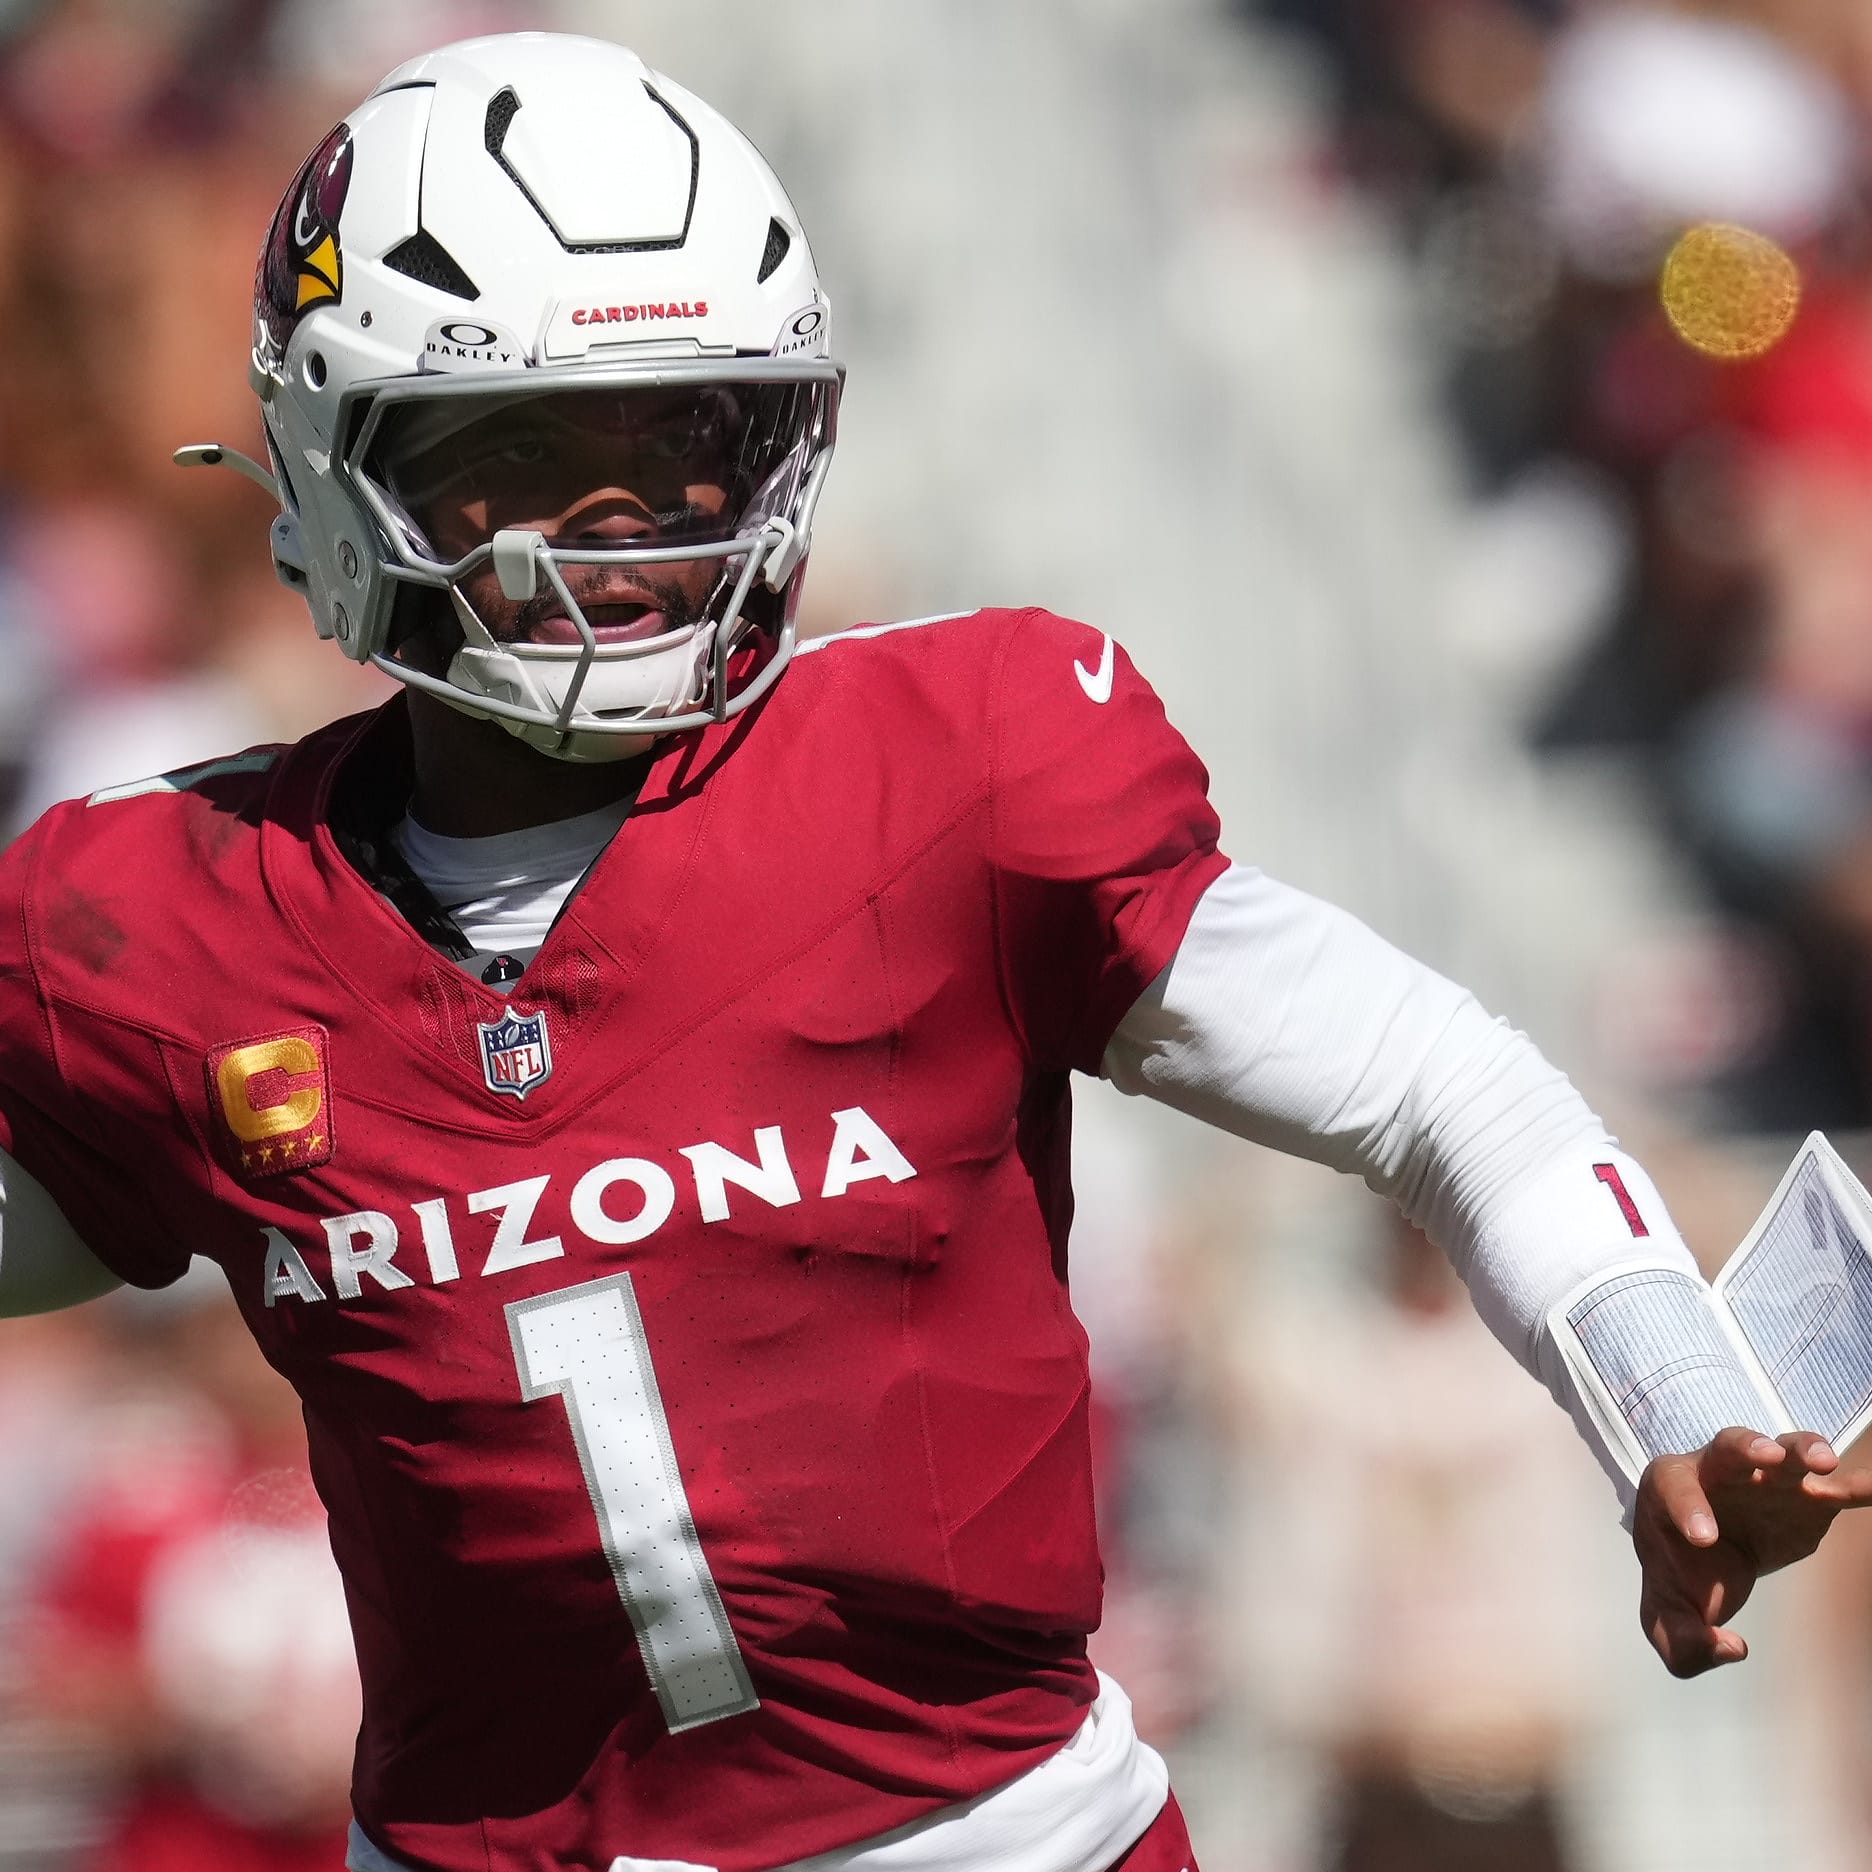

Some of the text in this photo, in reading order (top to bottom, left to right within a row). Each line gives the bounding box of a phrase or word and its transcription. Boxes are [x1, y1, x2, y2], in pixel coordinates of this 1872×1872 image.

[571, 301, 709, 326] CARDINALS
[426, 342, 511, 363] OAKLEY
[216, 1036, 322, 1143] C
[492, 1048, 540, 1083] NFL
[258, 1105, 918, 1308] ARIZONA
[1591, 1162, 1650, 1238] 1
[502, 1270, 761, 1736] 1
